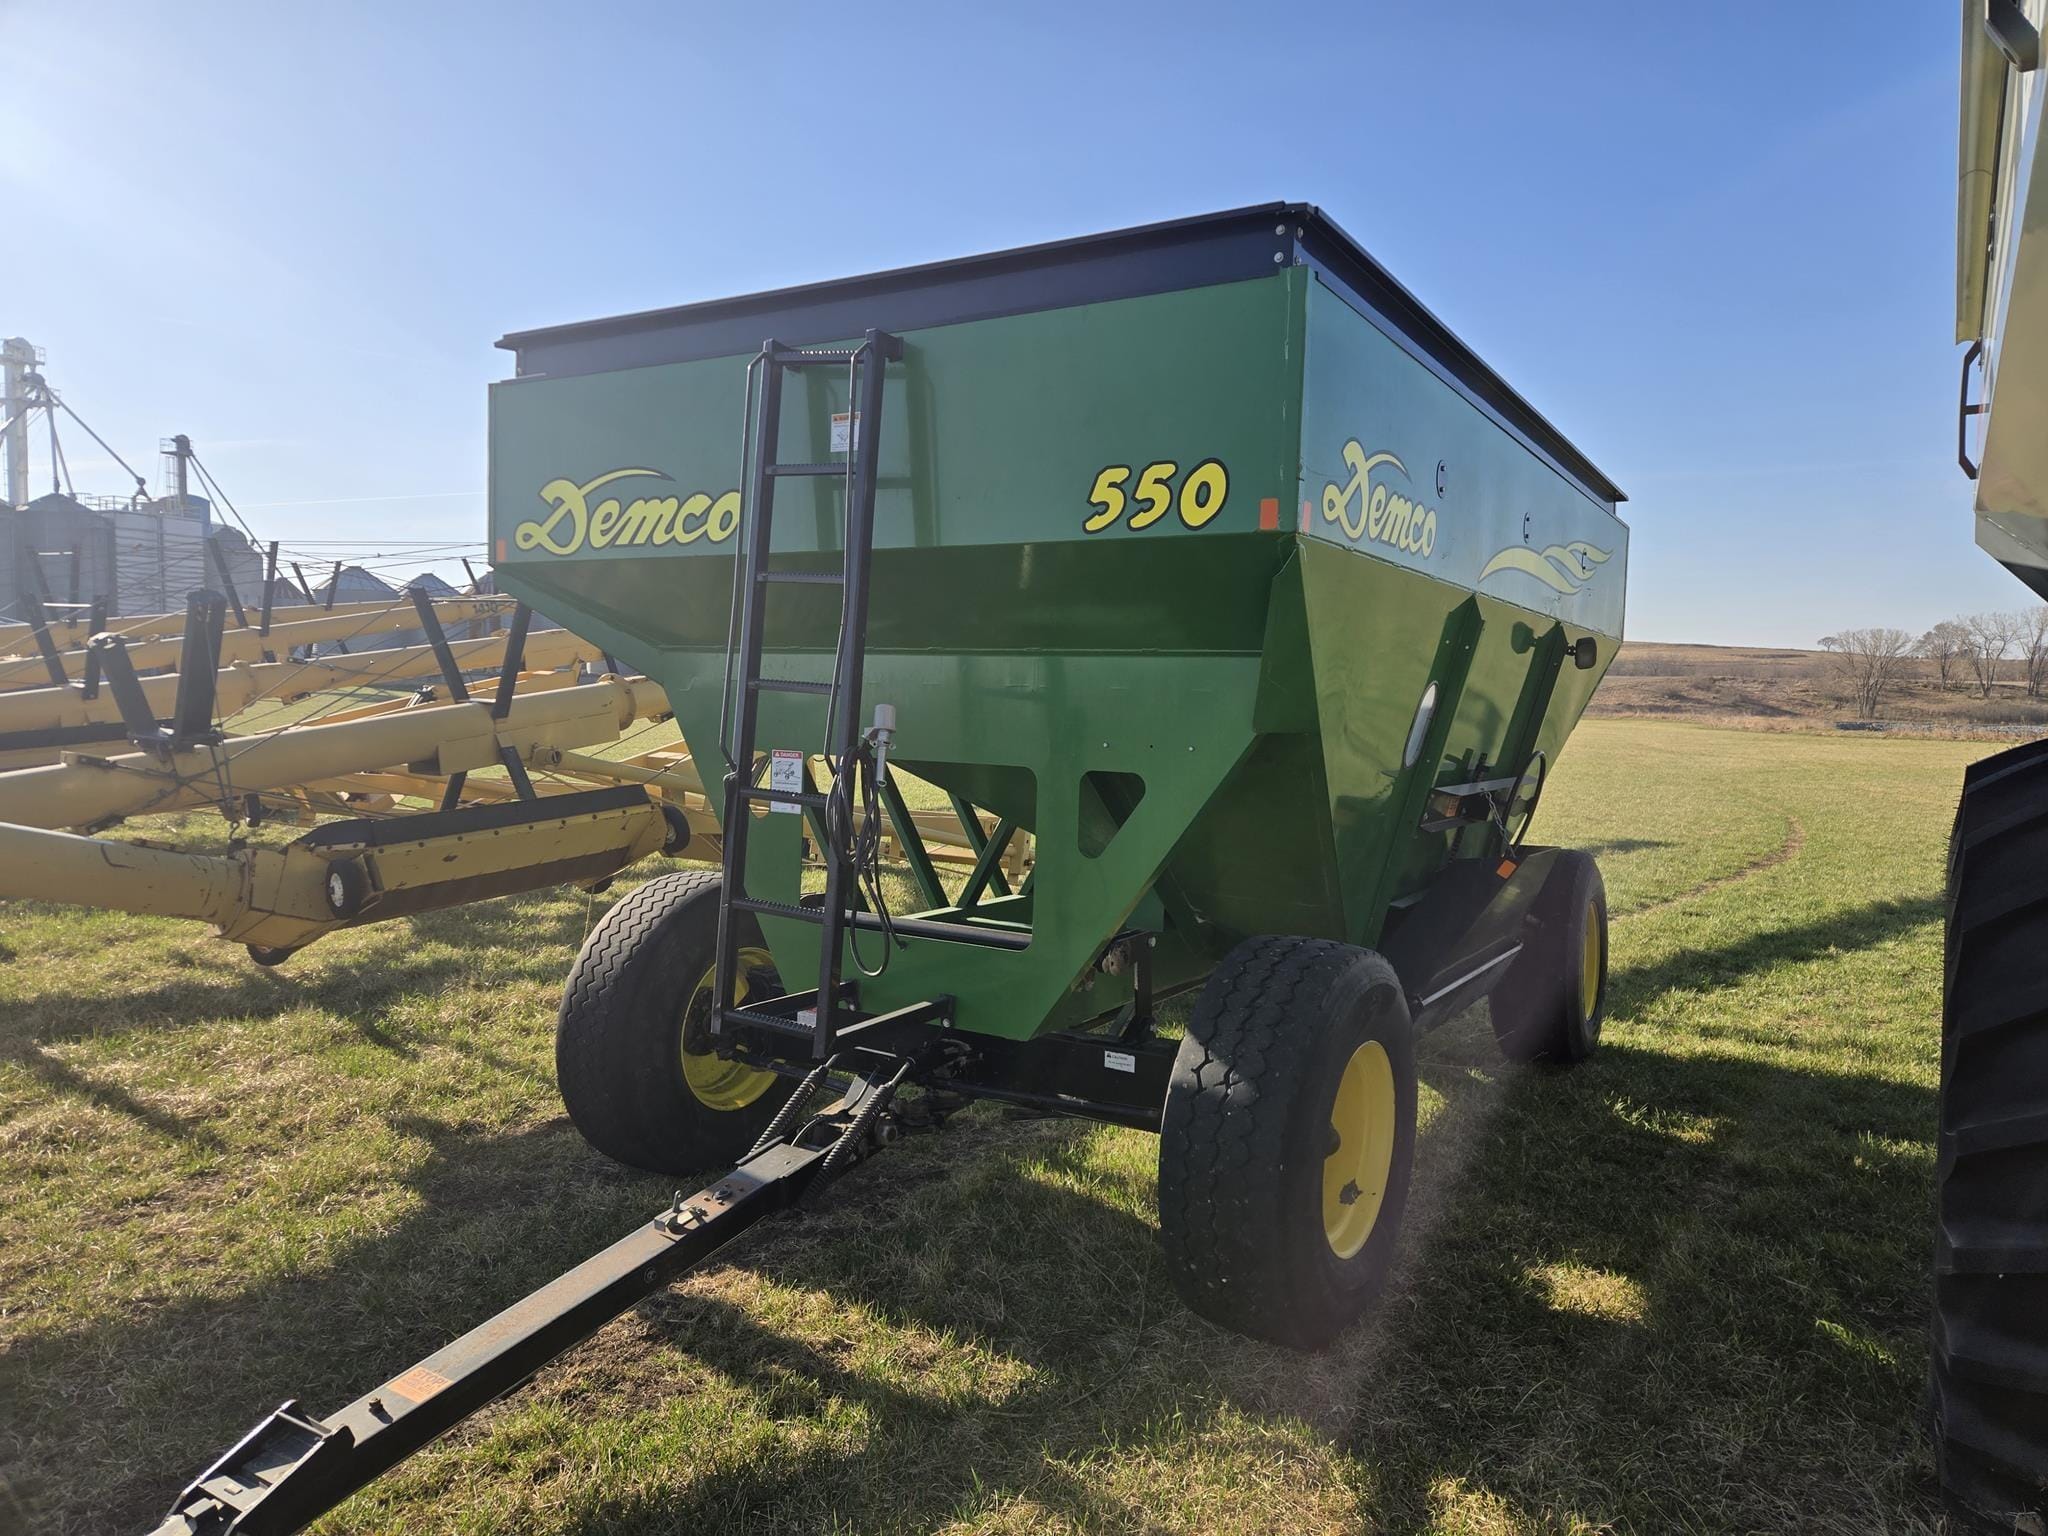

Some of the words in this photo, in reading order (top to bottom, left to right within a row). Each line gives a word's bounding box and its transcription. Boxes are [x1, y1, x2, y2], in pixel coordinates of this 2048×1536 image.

[515, 466, 741, 556] Demco
[1082, 457, 1230, 534] 550
[1322, 437, 1437, 558] Demco
